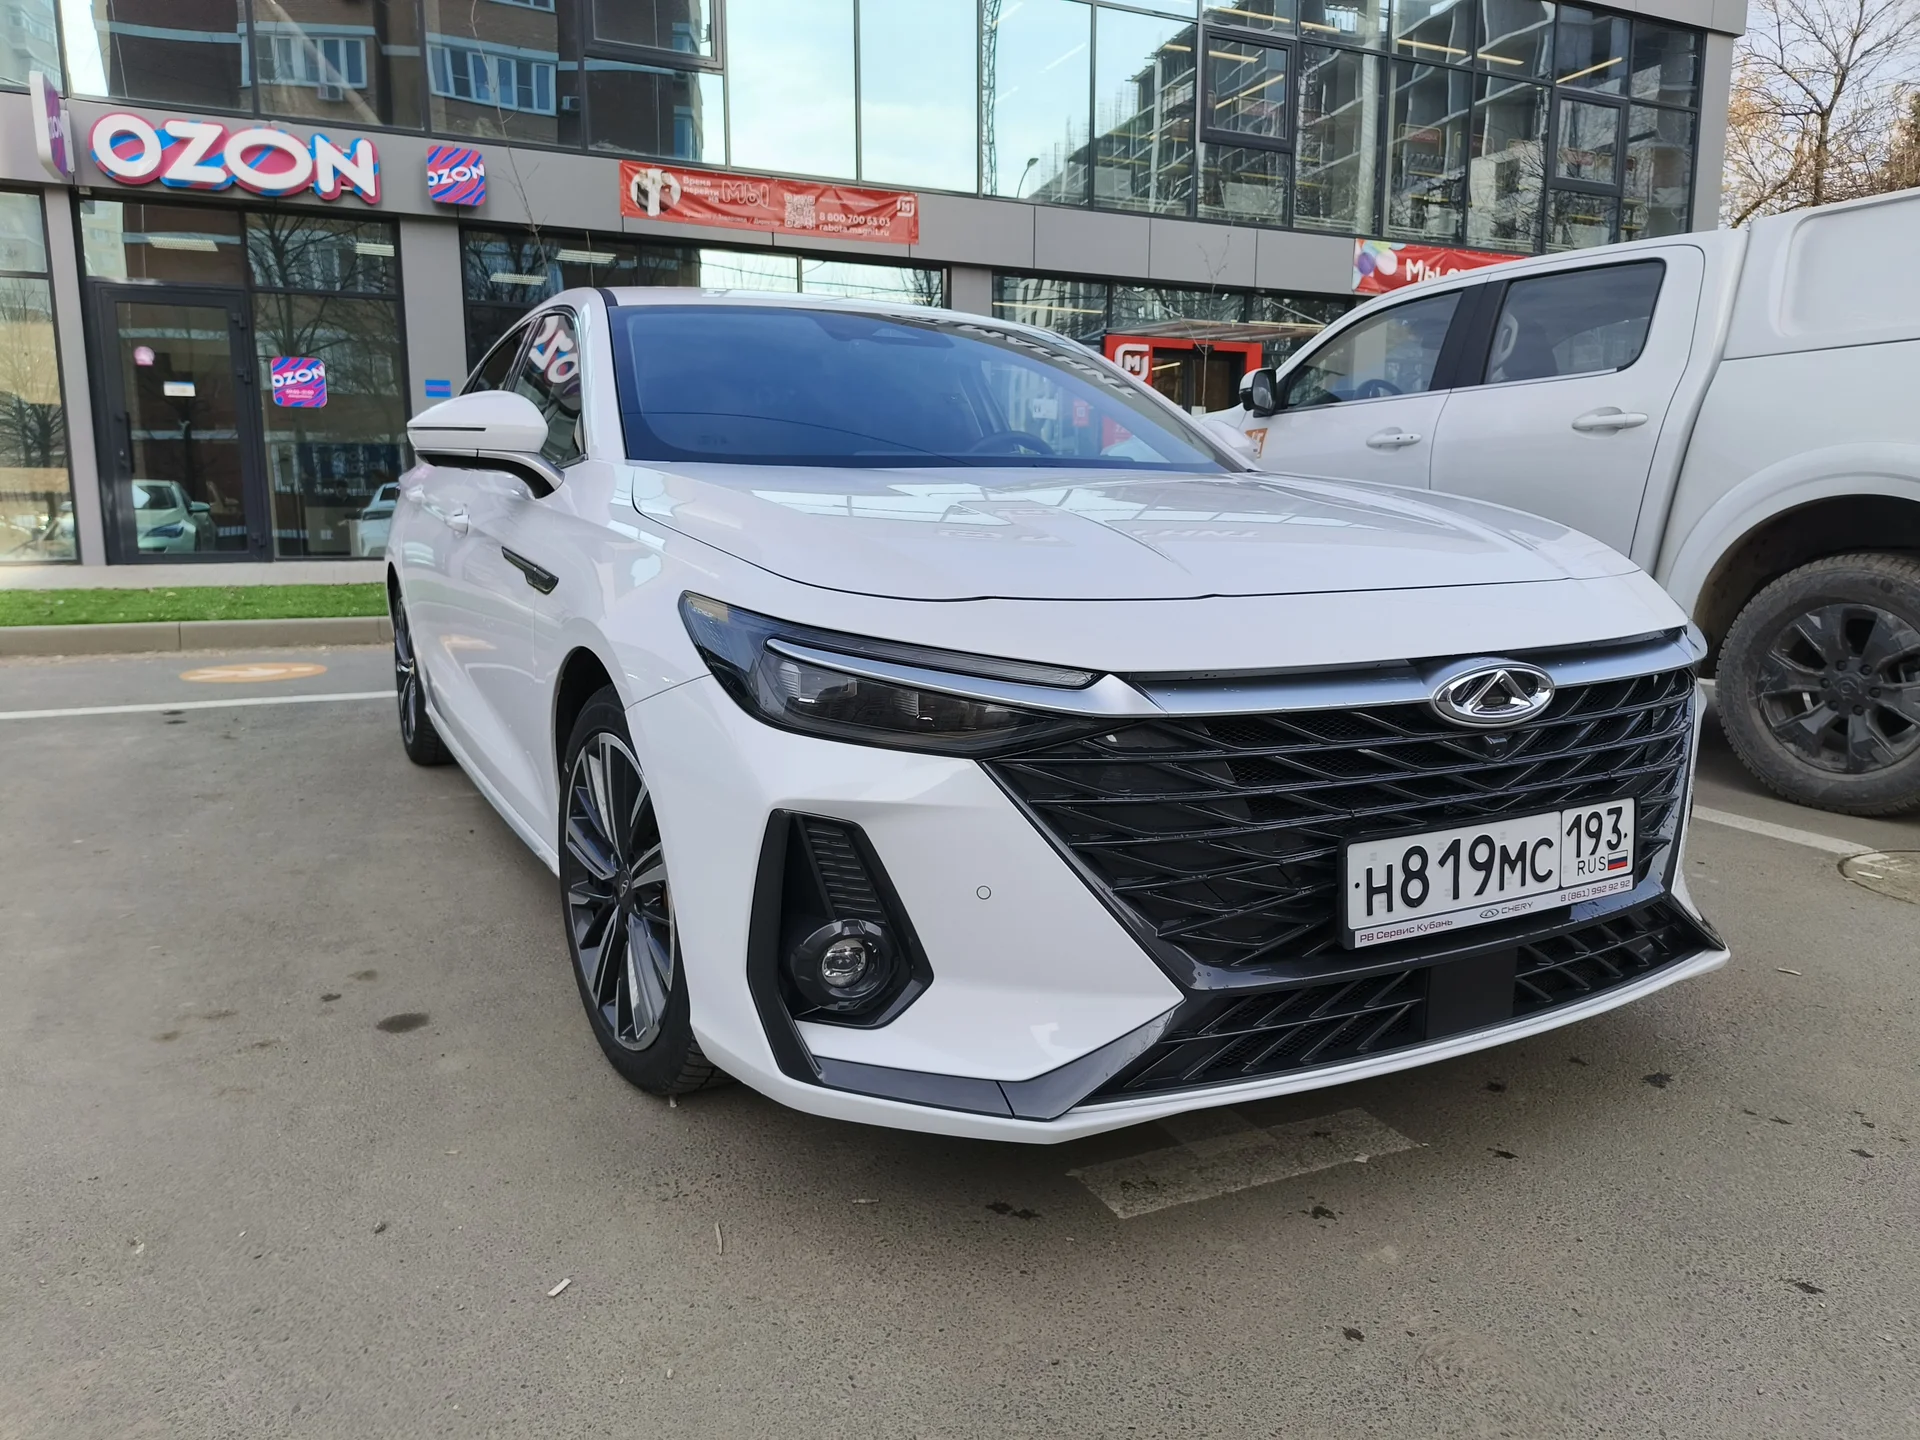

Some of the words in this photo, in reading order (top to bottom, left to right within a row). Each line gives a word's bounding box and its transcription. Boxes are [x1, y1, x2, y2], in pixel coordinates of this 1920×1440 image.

[92, 113, 378, 198] OZON
[428, 164, 485, 187] OZON
[683, 175, 712, 187] Время
[683, 187, 719, 197] перейти
[819, 212, 826, 221] 8
[827, 213, 846, 223] 800
[848, 214, 865, 225] 700
[819, 223, 890, 236] rabota.magnit.ru
[272, 365, 325, 387] OZON
[1566, 806, 1623, 858] 193
[1577, 856, 1606, 876] RUS
[1560, 894, 1567, 902] 8
[1567, 888, 1590, 901] (861)
[1591, 883, 1607, 896] 992
[1608, 881, 1619, 892] 92
[1620, 879, 1631, 889] 92
[1501, 901, 1534, 914] CHERY
[1377, 926, 1415, 940] Сервис
[1416, 919, 1453, 933] Кубань
